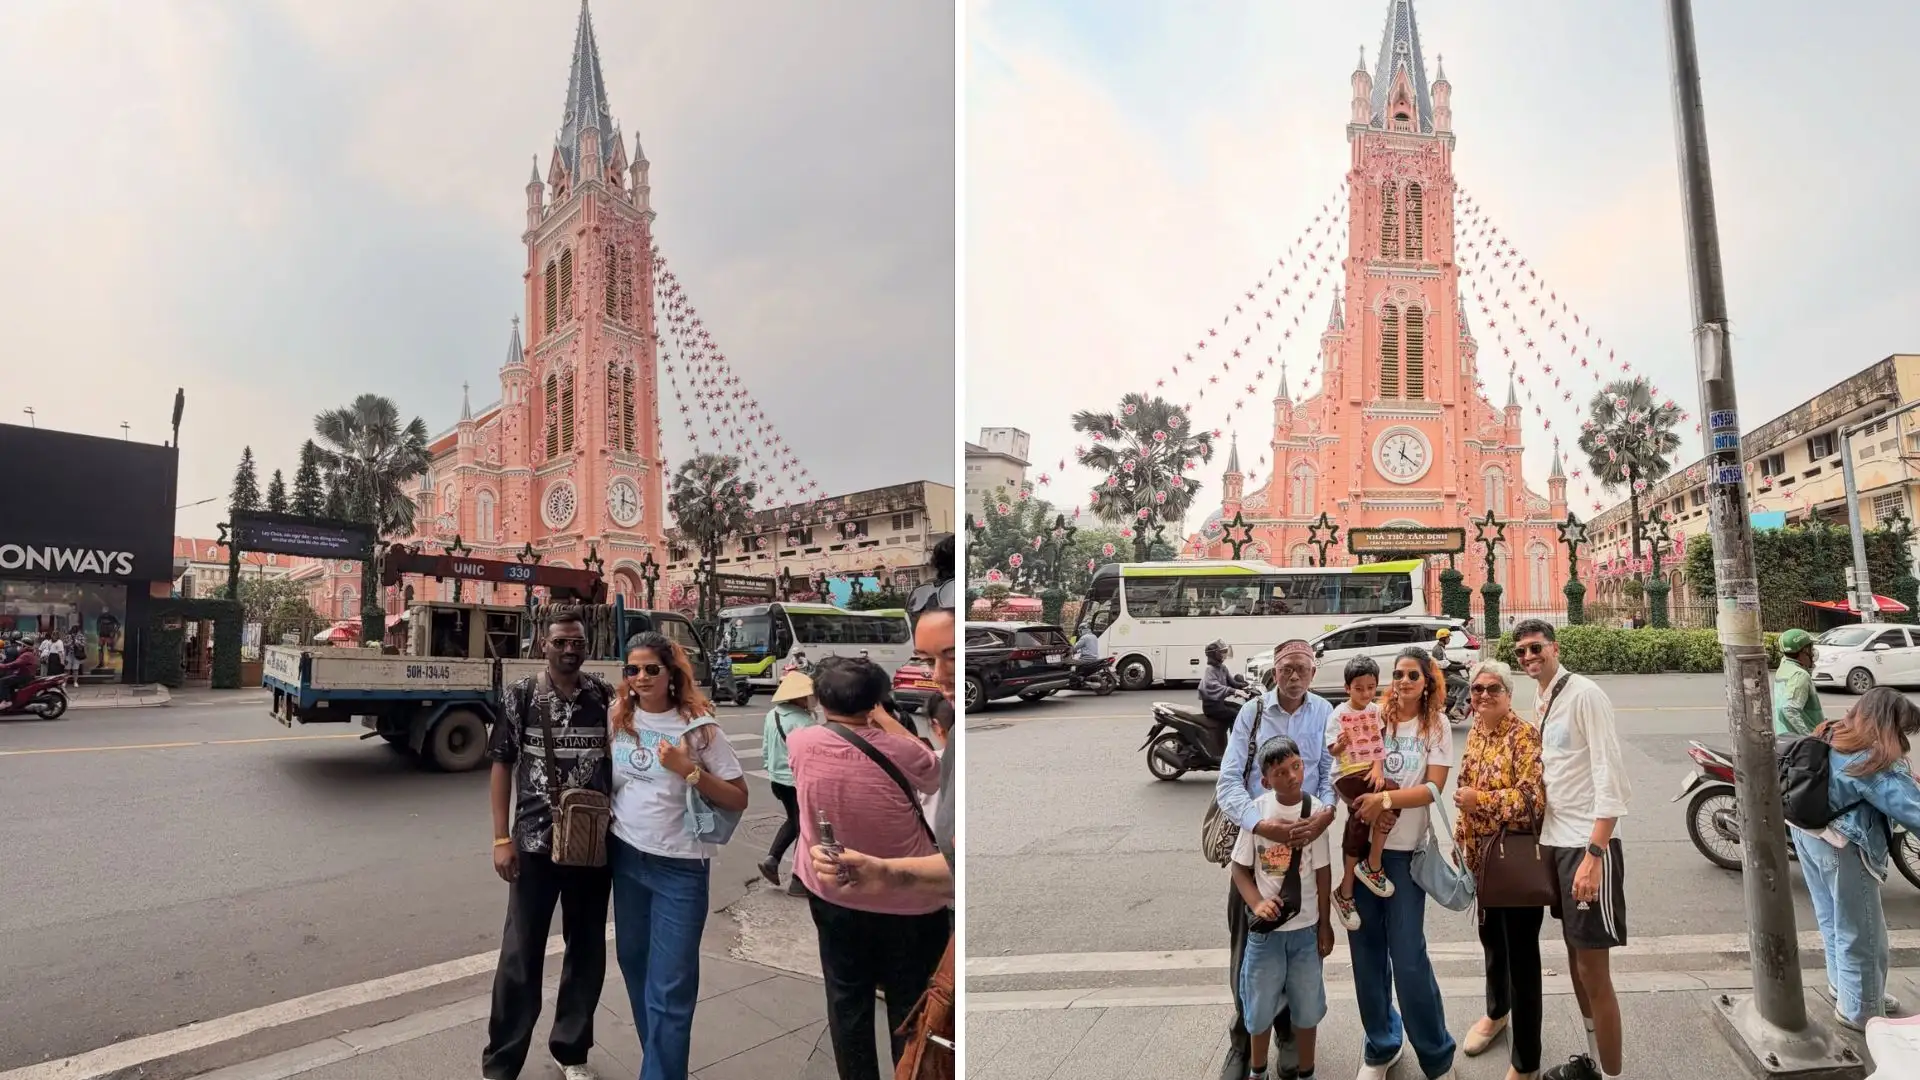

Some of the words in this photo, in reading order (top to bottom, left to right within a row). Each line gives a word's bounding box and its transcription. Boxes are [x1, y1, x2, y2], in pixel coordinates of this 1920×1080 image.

[1387, 532, 1405, 540] THỜ
[1426, 533, 1448, 541] ĐỊNH
[0, 544, 134, 575] ONWAYS
[454, 562, 485, 576] UNIC
[509, 567, 531, 579] 330
[529, 736, 588, 749] CHISTIAN
